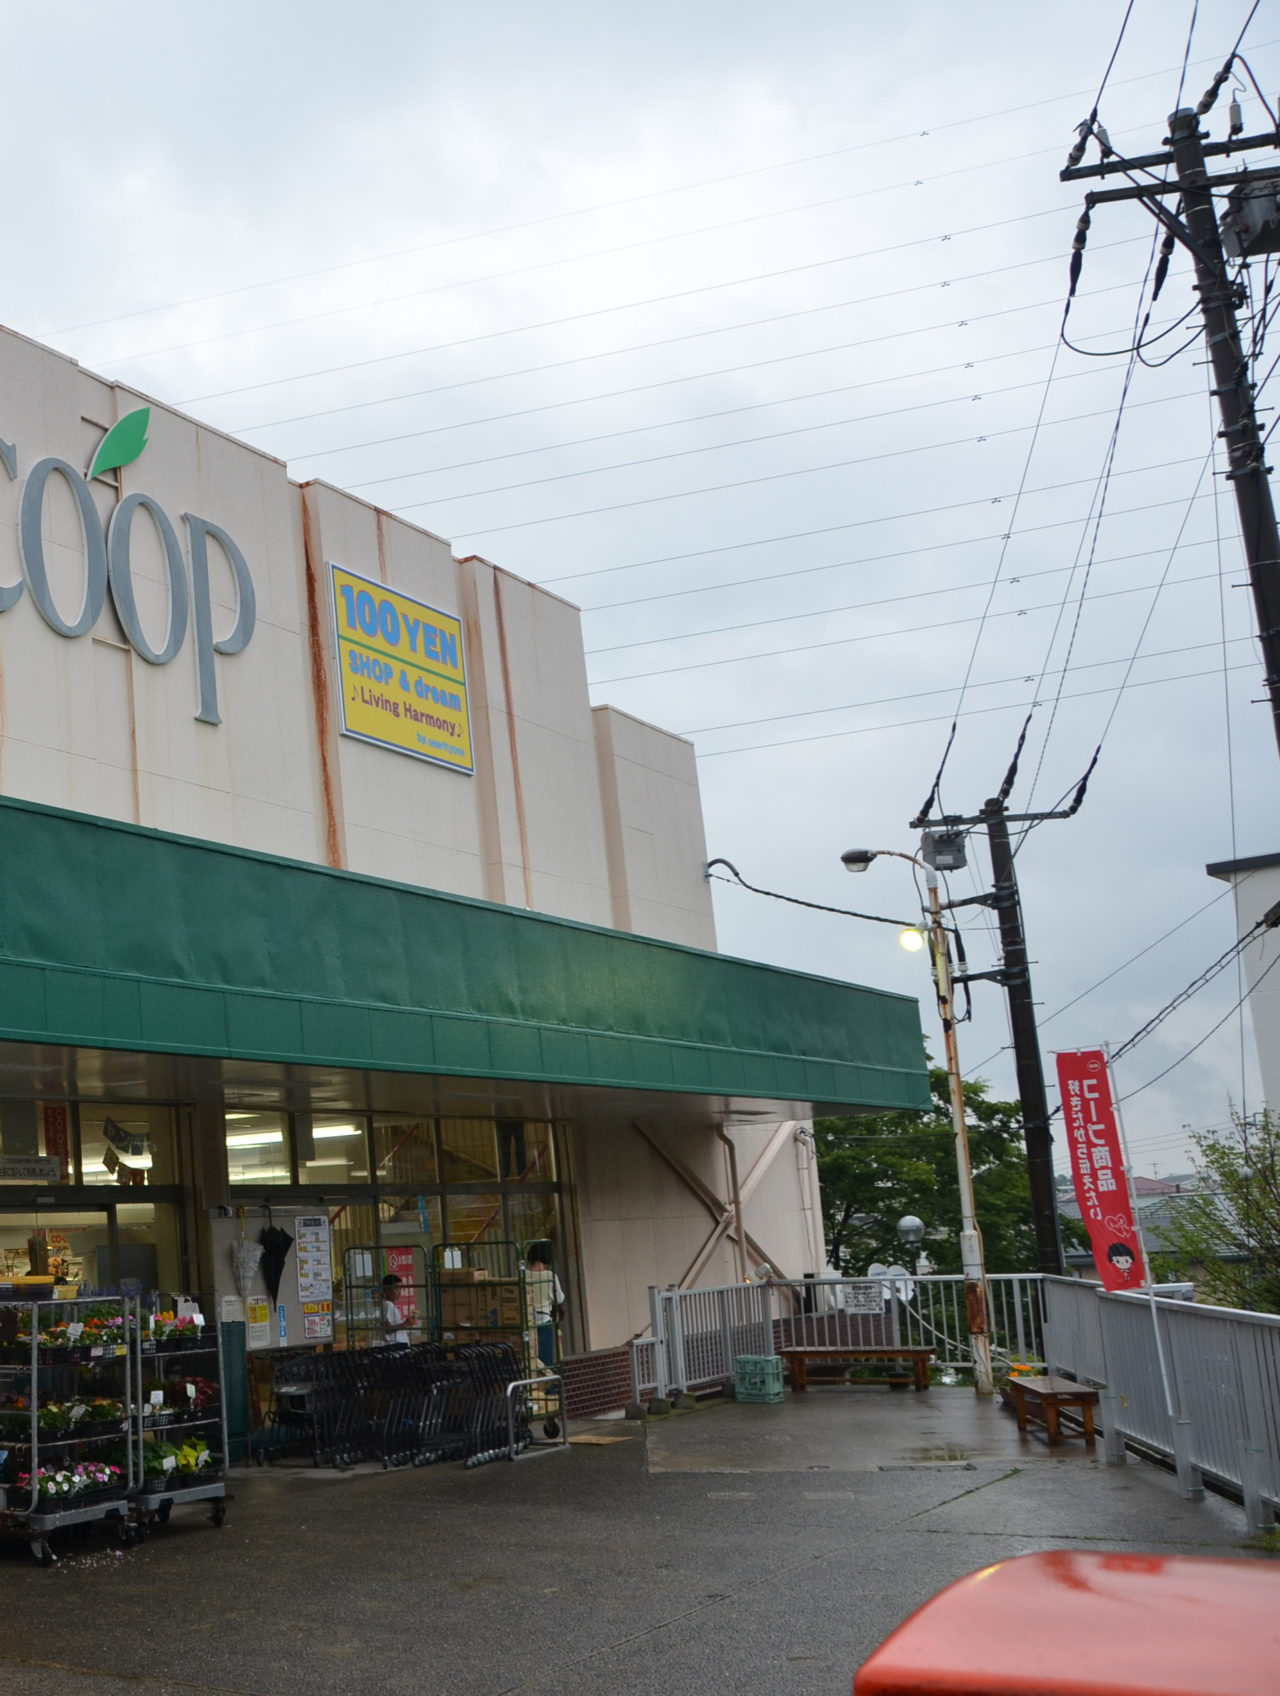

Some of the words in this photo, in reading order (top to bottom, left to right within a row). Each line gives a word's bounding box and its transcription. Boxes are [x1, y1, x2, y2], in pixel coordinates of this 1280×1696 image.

[340, 584, 400, 647] 100
[401, 613, 459, 670] YEN
[348, 649, 393, 685] SHOP
[399, 669, 411, 692] &
[414, 676, 462, 712] dream
[361, 686, 400, 717] Living
[404, 701, 456, 737] Harmony
